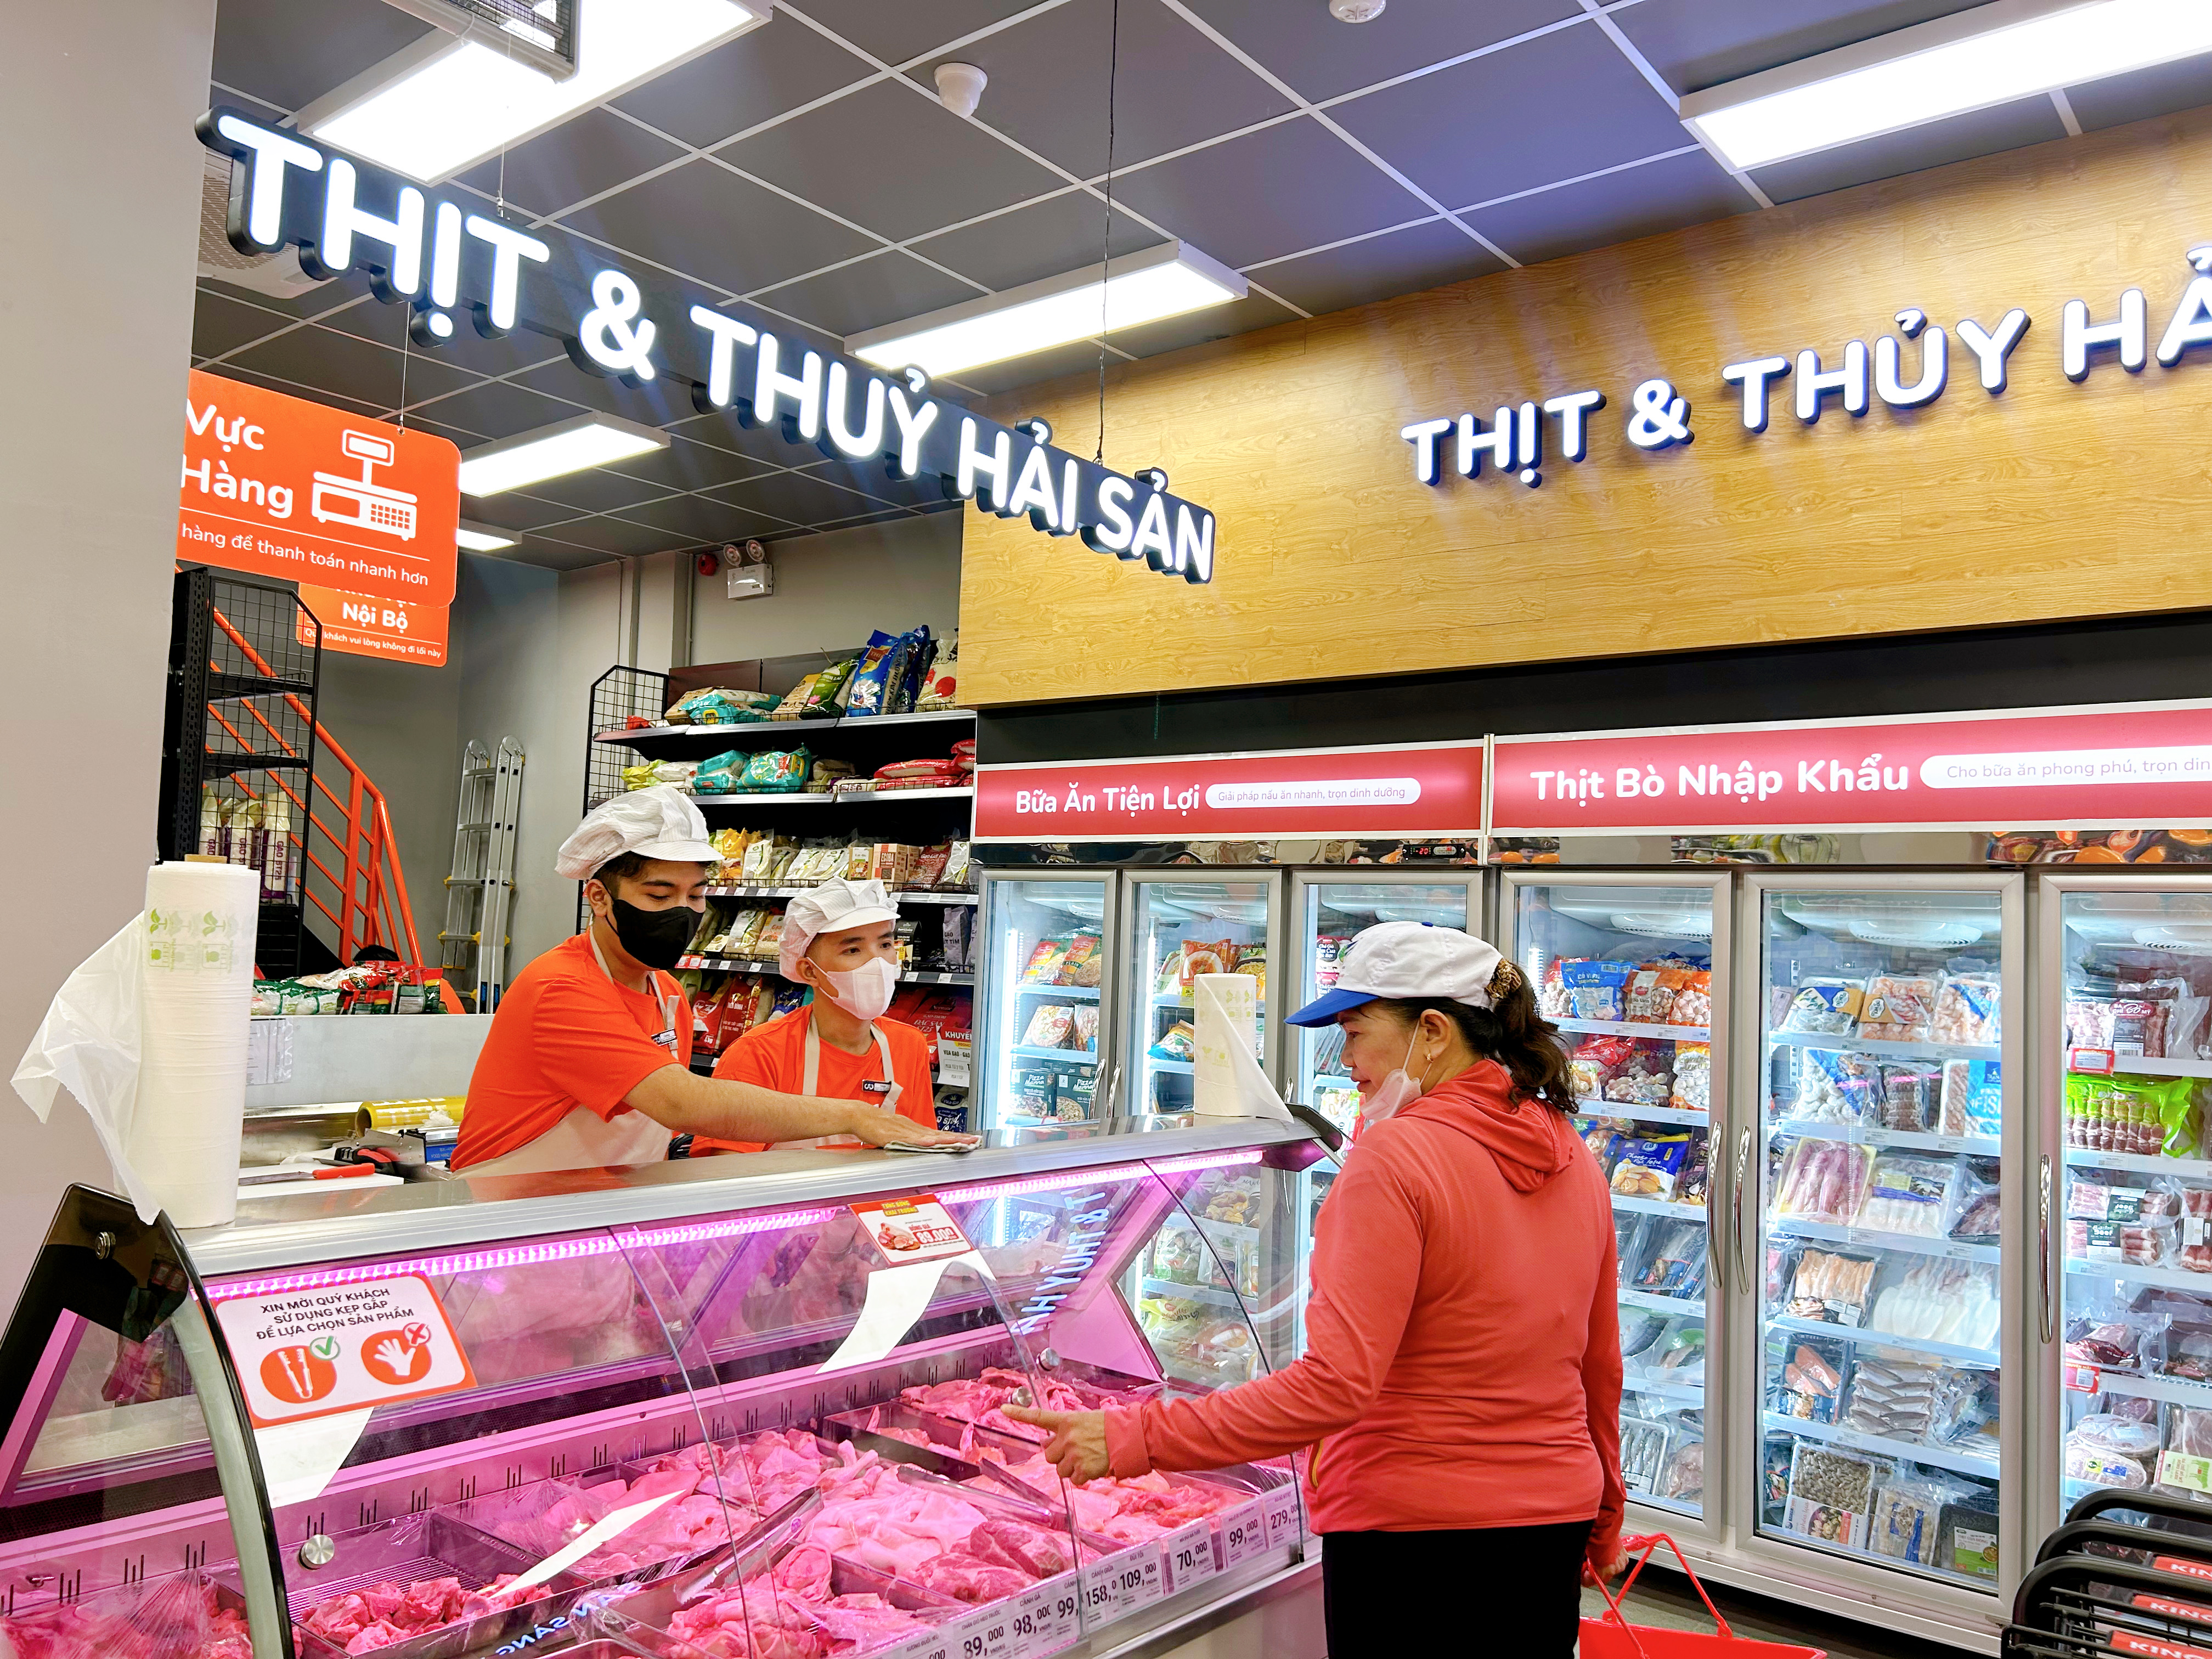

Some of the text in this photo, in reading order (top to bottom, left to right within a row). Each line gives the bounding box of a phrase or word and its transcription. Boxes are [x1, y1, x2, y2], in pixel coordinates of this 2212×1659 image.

[219, 116, 1211, 580] THỊT & THUỶ HẢI SẢN
[1400, 389, 1605, 487] THỊT
[1628, 377, 1695, 449] &
[1722, 308, 2031, 433] THỦY
[187, 398, 264, 453] Vực
[180, 454, 294, 518] Hàng
[182, 523, 428, 585] hàng để thanh toán nhanh hơn
[343, 602, 408, 634] Nội Bộ
[306, 628, 317, 639] Qu
[324, 631, 348, 642] khách
[349, 636, 362, 645] vui
[363, 637, 381, 649] lòng
[382, 642, 407, 653] không
[428, 649, 441, 658] này
[1530, 753, 1909, 807] Thịt Bò Nhập Khẩu
[1947, 757, 2210, 778] Cho bữa ăn phong phú, trọn din
[1016, 781, 1200, 817] Bữa Ăn Tiện Lợi
[1218, 786, 1405, 803] Giải pháp nấu ăn nhanh, trọn dinh dưỡng
[260, 1288, 390, 1313] XIN MỜI QUÝ KHÁCH
[274, 1297, 388, 1324] SỬ DỤNG KẸP GẮP
[256, 1306, 415, 1340] ĐỂ LỰA CHỌN SẢN PHẨM
